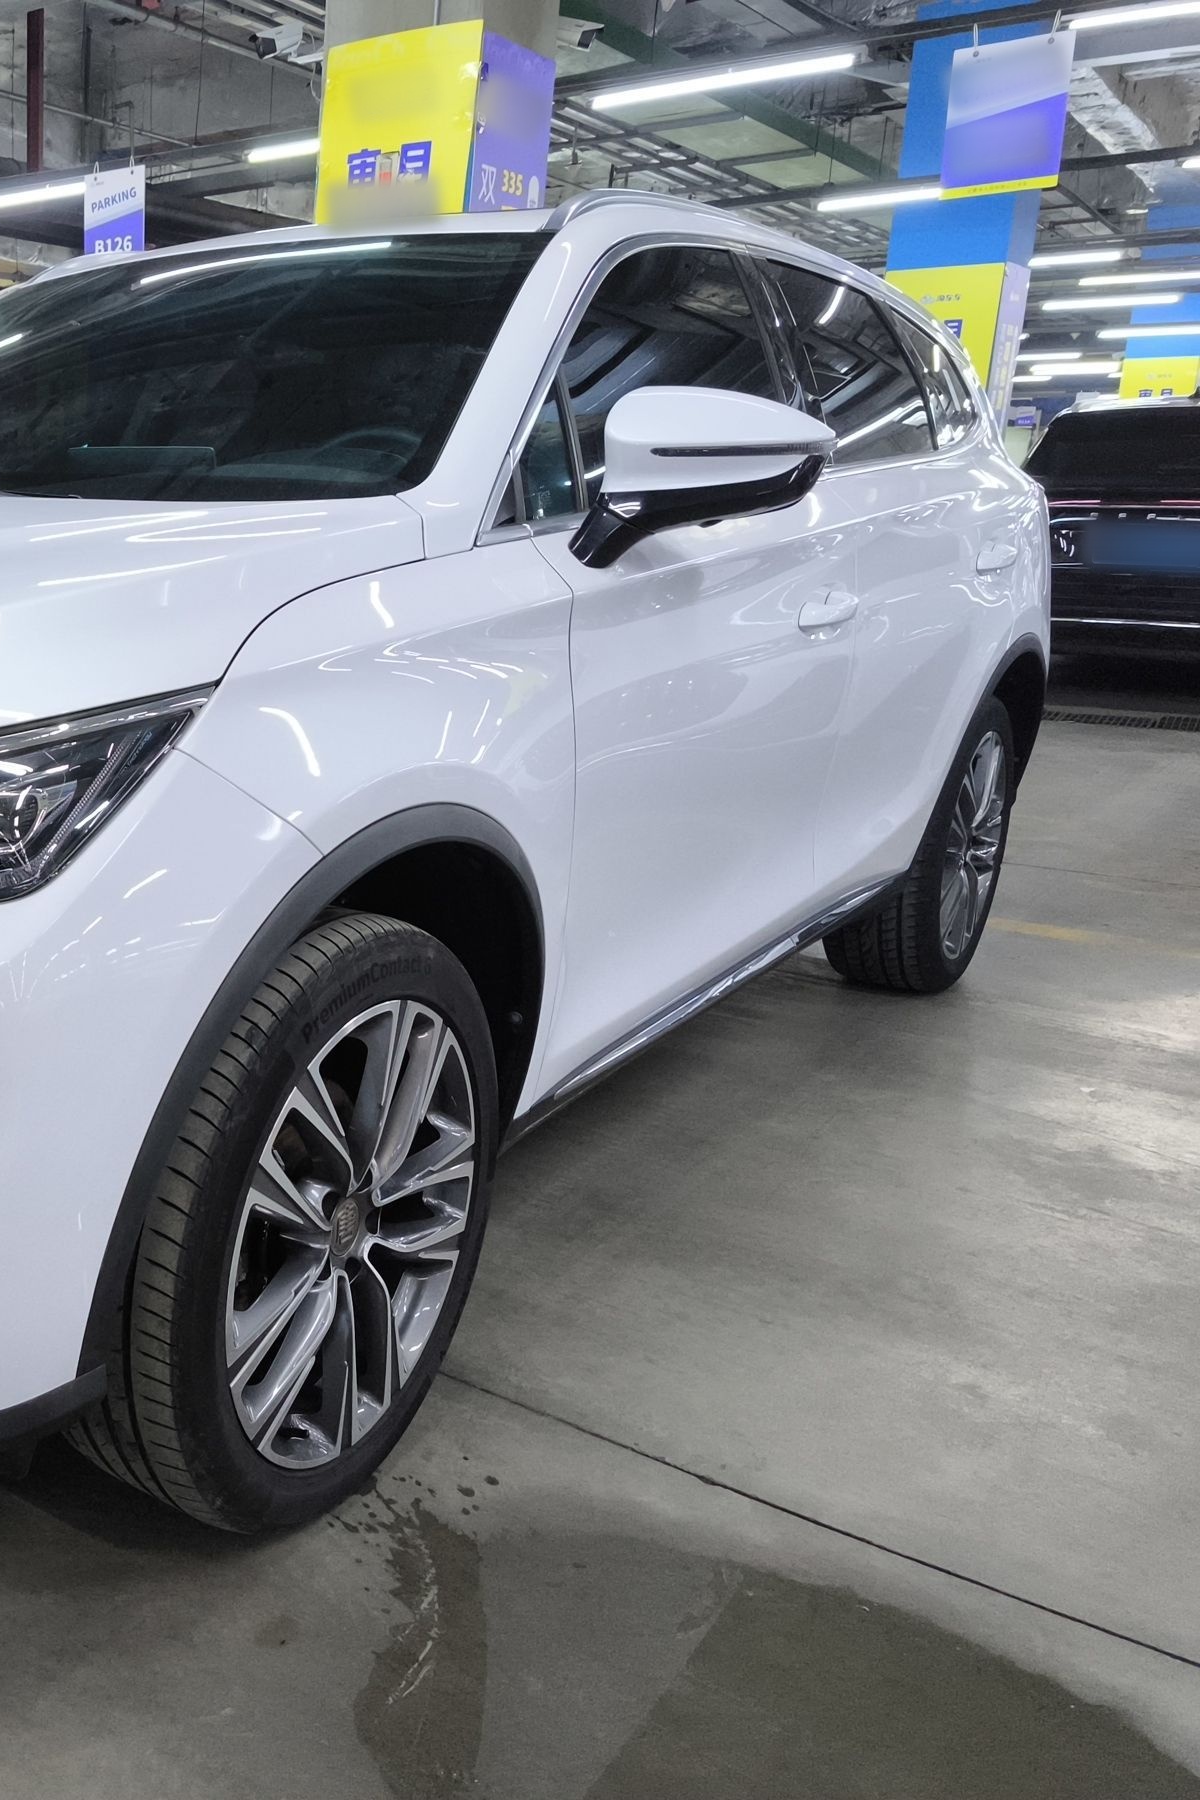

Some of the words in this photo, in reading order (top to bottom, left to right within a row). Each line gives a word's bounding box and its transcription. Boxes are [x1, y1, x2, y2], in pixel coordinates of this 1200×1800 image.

[501, 169, 523, 196] 335
[91, 186, 137, 214] PARKING
[95, 235, 133, 255] B126
